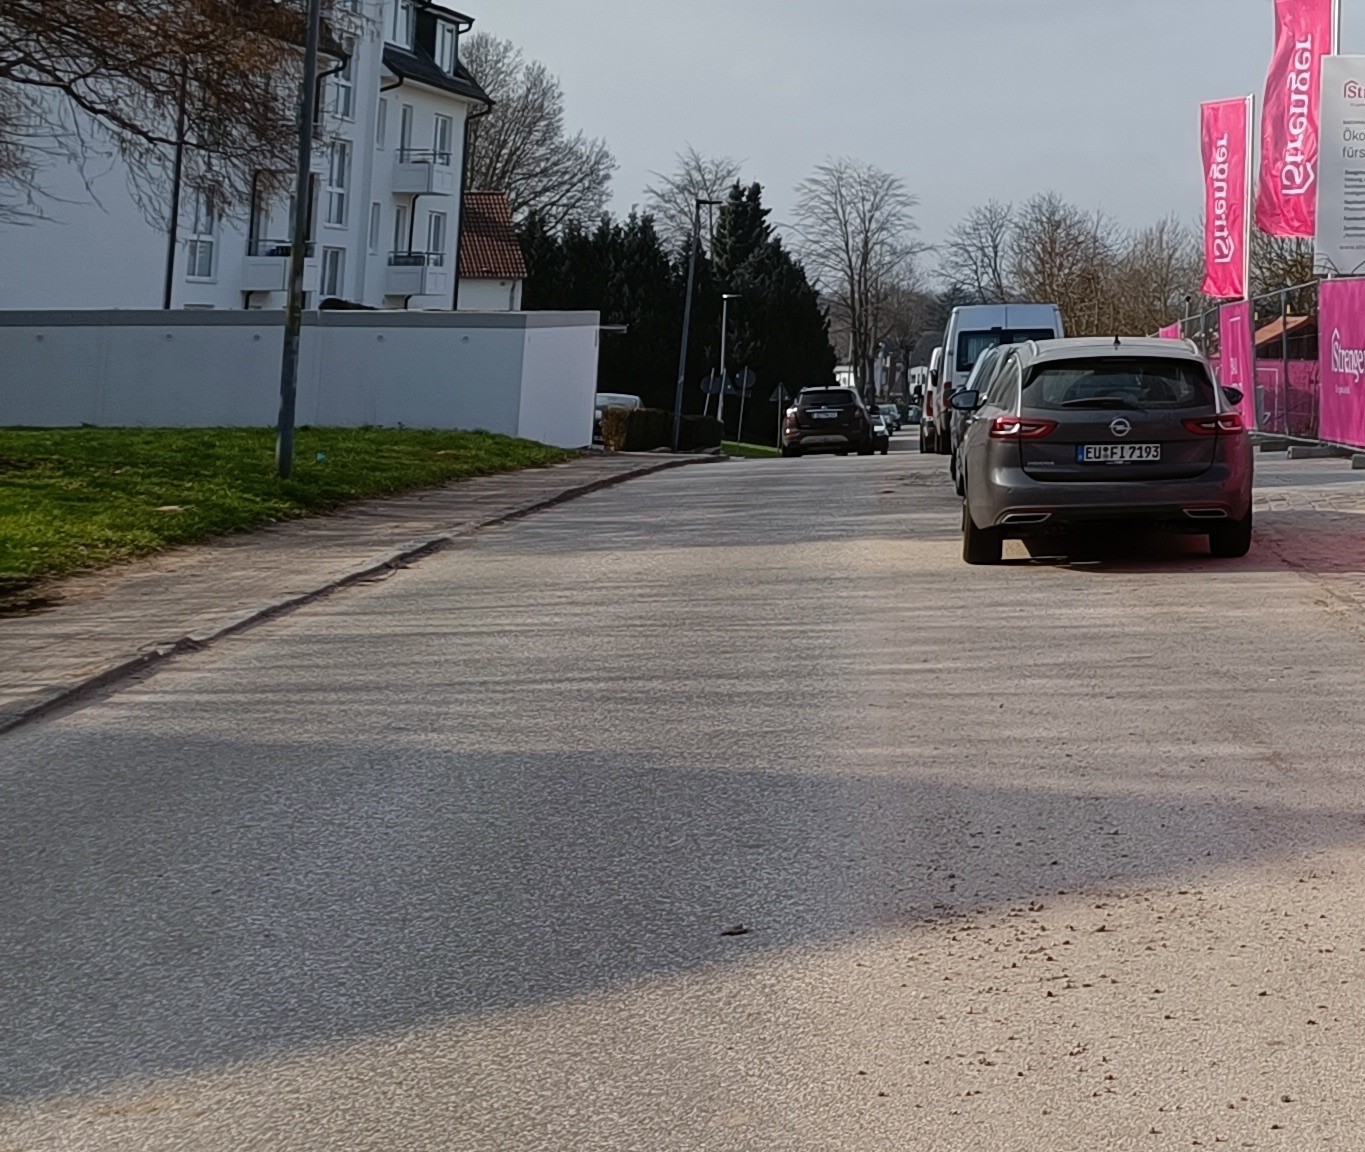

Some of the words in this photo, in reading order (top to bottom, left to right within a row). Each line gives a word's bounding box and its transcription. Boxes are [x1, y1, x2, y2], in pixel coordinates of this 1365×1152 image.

[1342, 146, 1365, 158] fürs
[1085, 446, 1102, 459] EU
[1128, 446, 1160, 458] 7193
